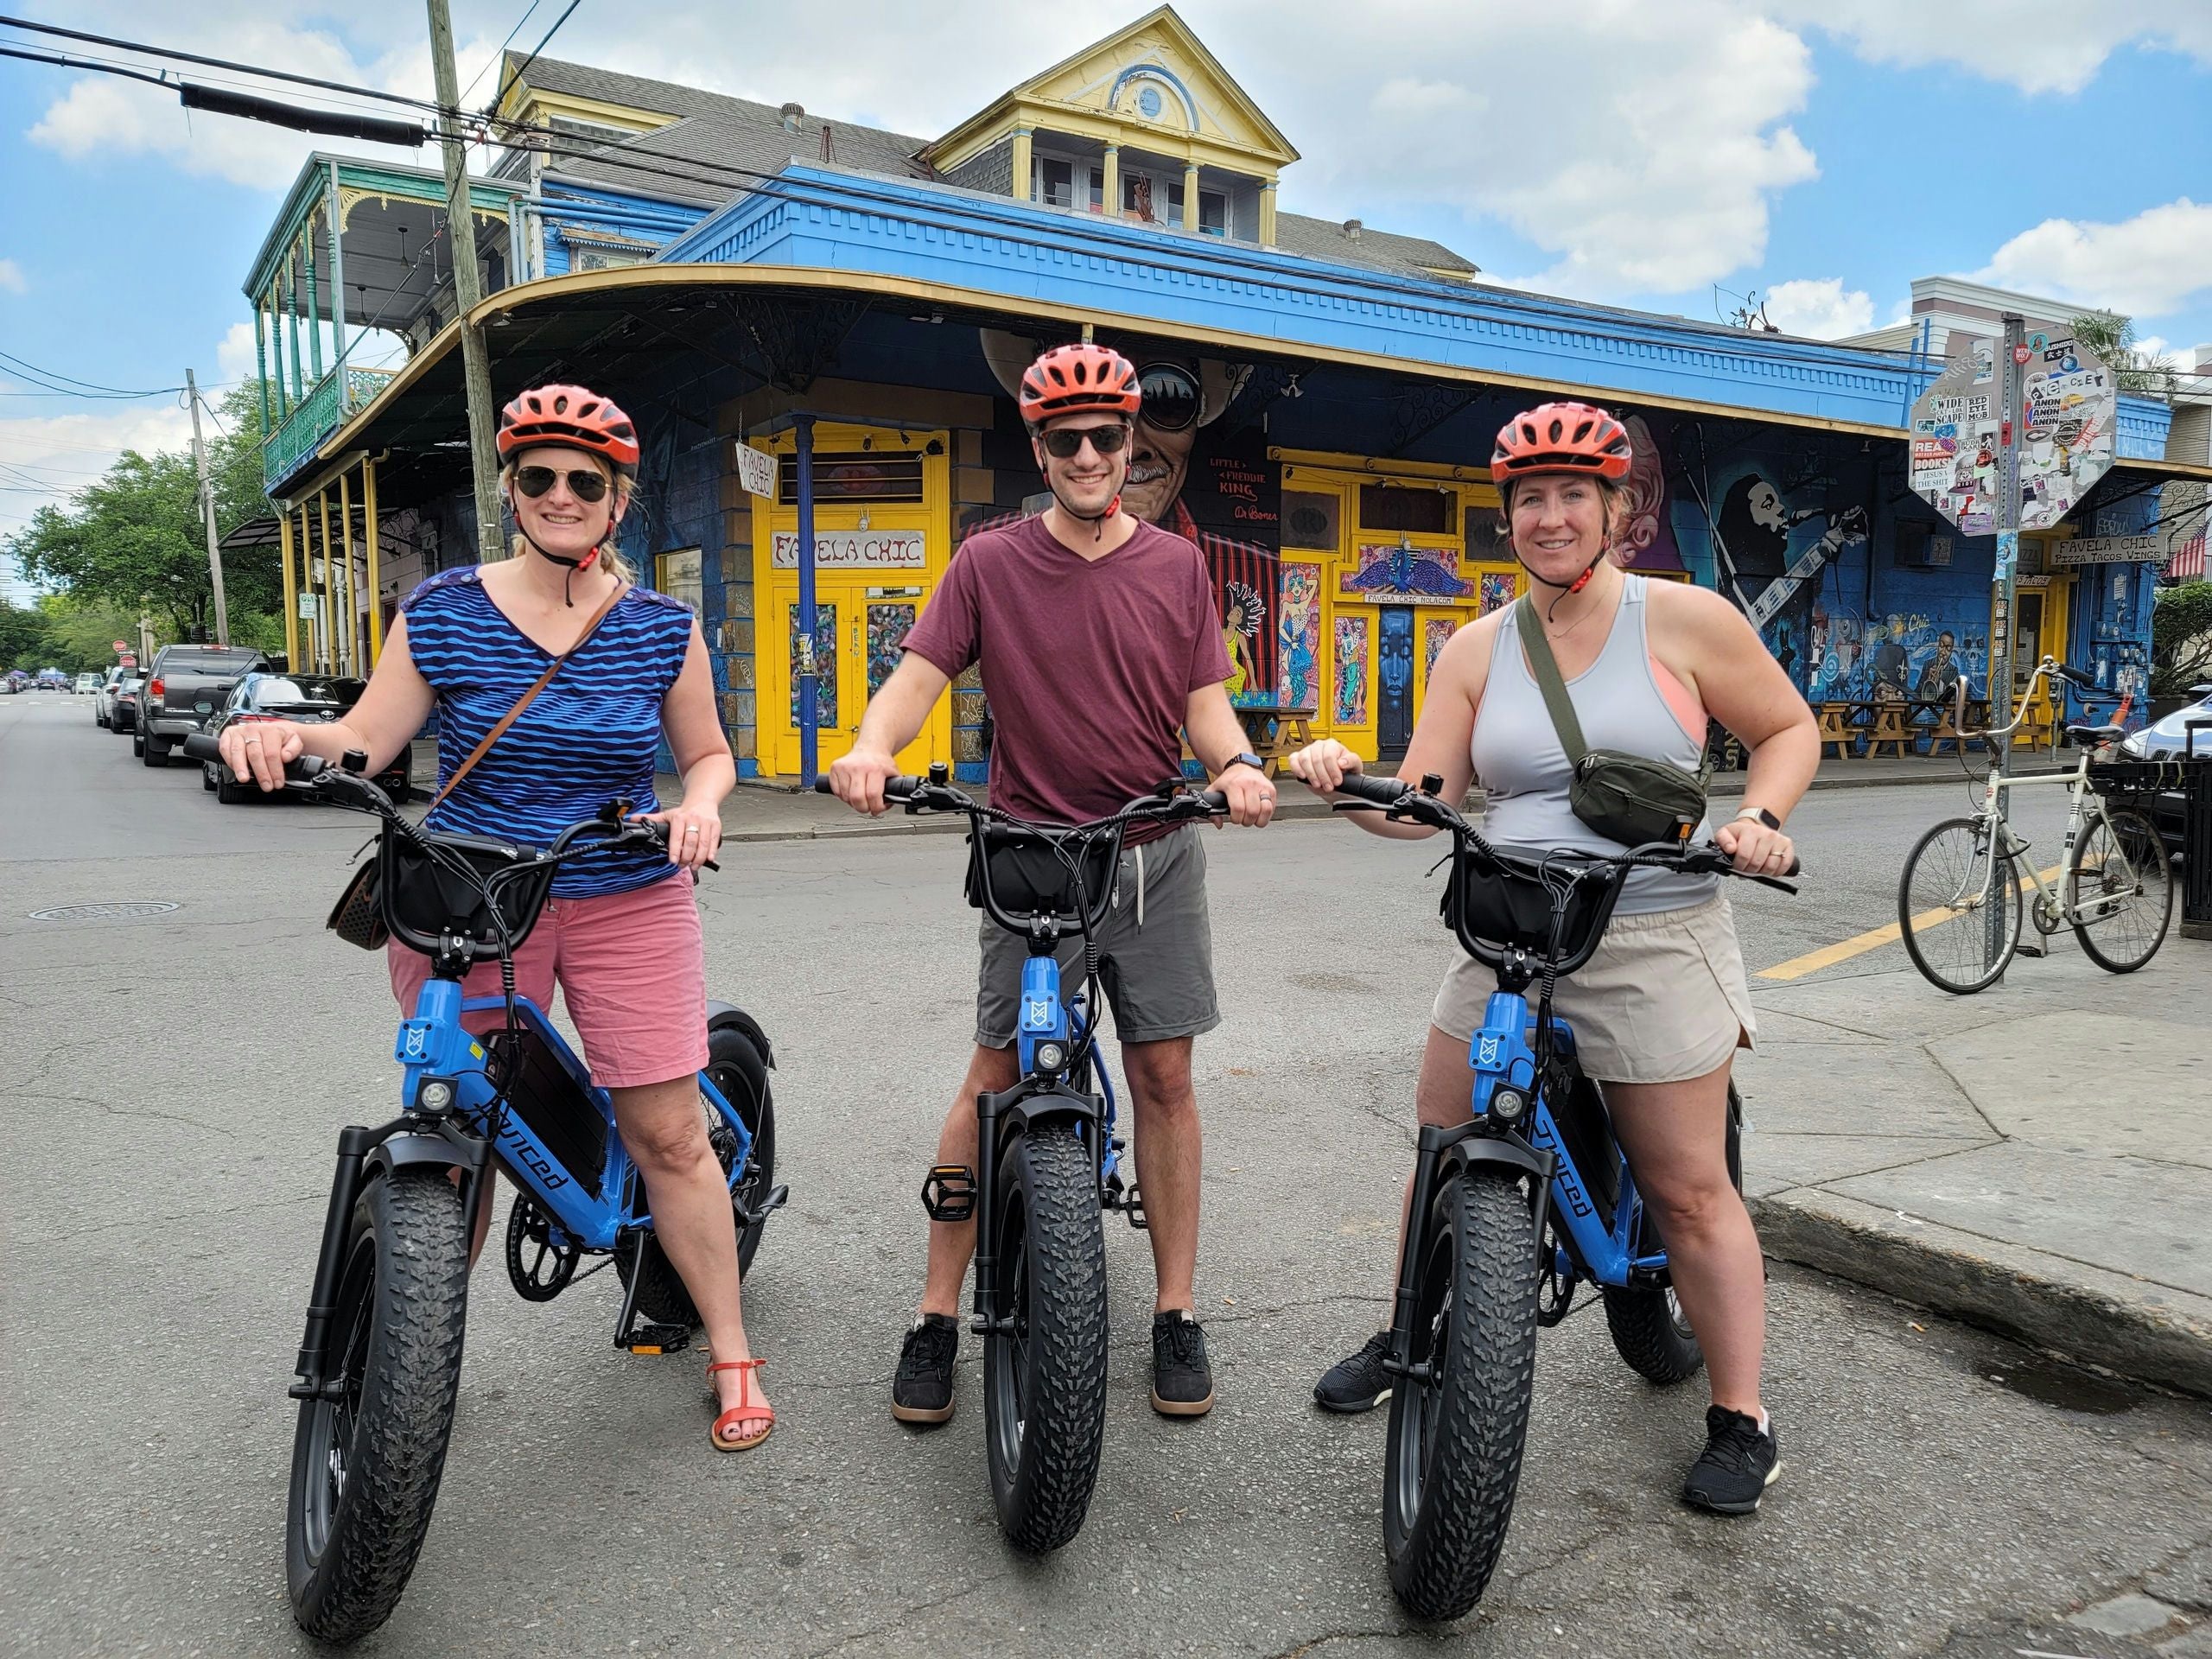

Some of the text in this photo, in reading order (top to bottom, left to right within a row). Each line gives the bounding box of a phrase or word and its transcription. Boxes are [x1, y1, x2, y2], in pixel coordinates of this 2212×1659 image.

[1938, 398, 1963, 409] WIDE
[1936, 413, 1963, 424] SCAPE
[2032, 417, 2059, 426] ANON
[1915, 442, 1943, 452] REA
[743, 448, 774, 480] FAVELA
[1211, 458, 1240, 468] LITTLE
[1227, 471, 1266, 483] FREDDIE
[1923, 471, 1942, 480] JESUS
[749, 472, 770, 495] CHIC
[1220, 482, 1257, 499] KING
[775, 536, 921, 564] FAELA CHIC
[2060, 536, 2158, 554] FAVELA CHIC
[2056, 550, 2160, 563] PIZZA TACOS WINGS
